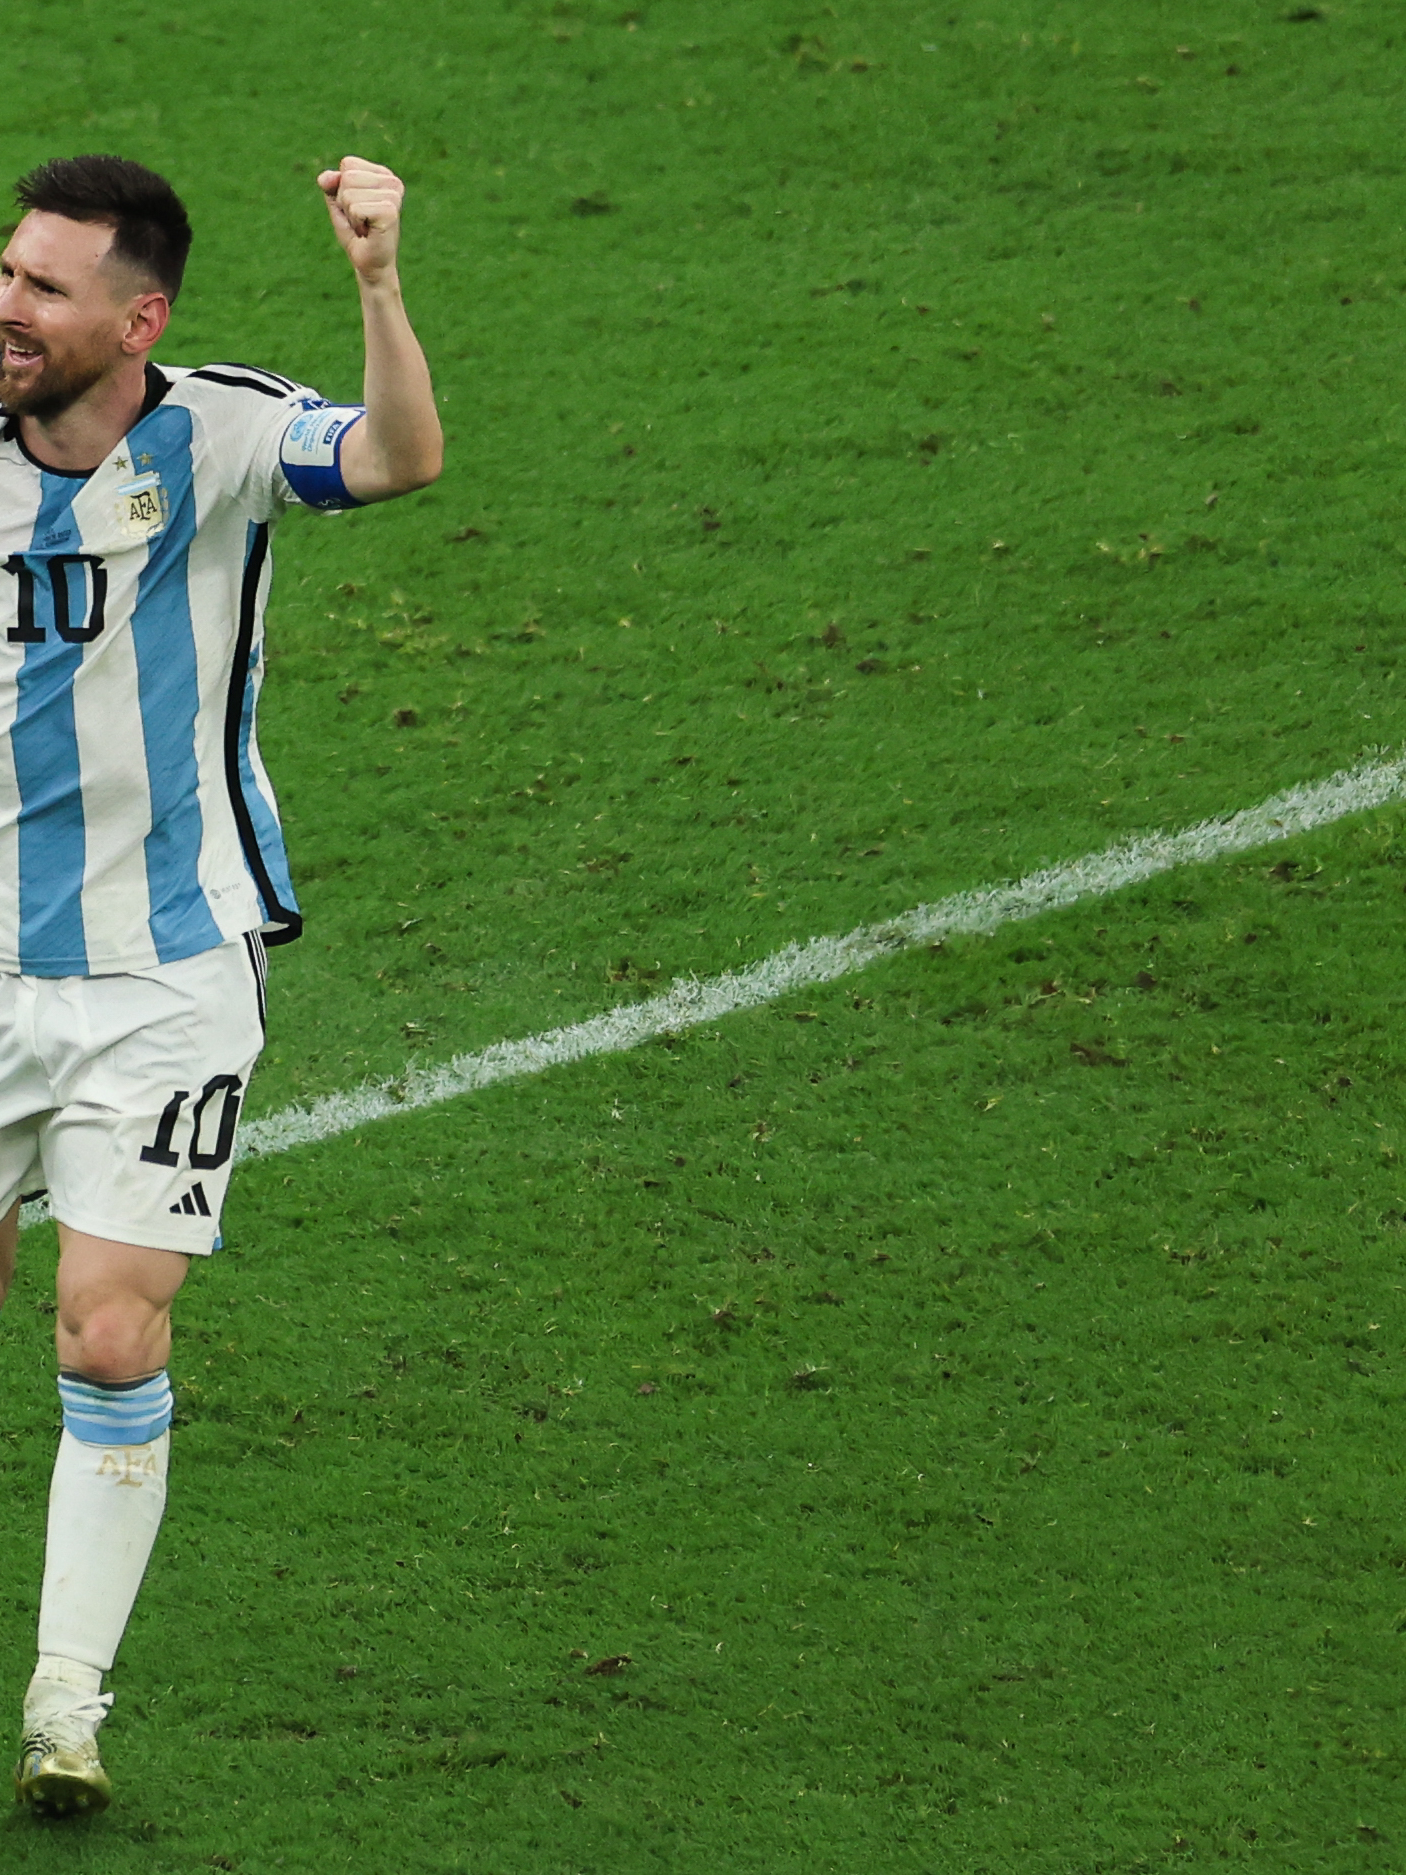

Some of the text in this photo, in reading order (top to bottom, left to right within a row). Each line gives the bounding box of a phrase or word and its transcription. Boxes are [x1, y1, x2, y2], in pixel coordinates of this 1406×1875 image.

[325, 423, 340, 442] FIFA
[130, 491, 157, 520] AFA
[2, 553, 108, 644] 10
[139, 1074, 243, 1170] 10
